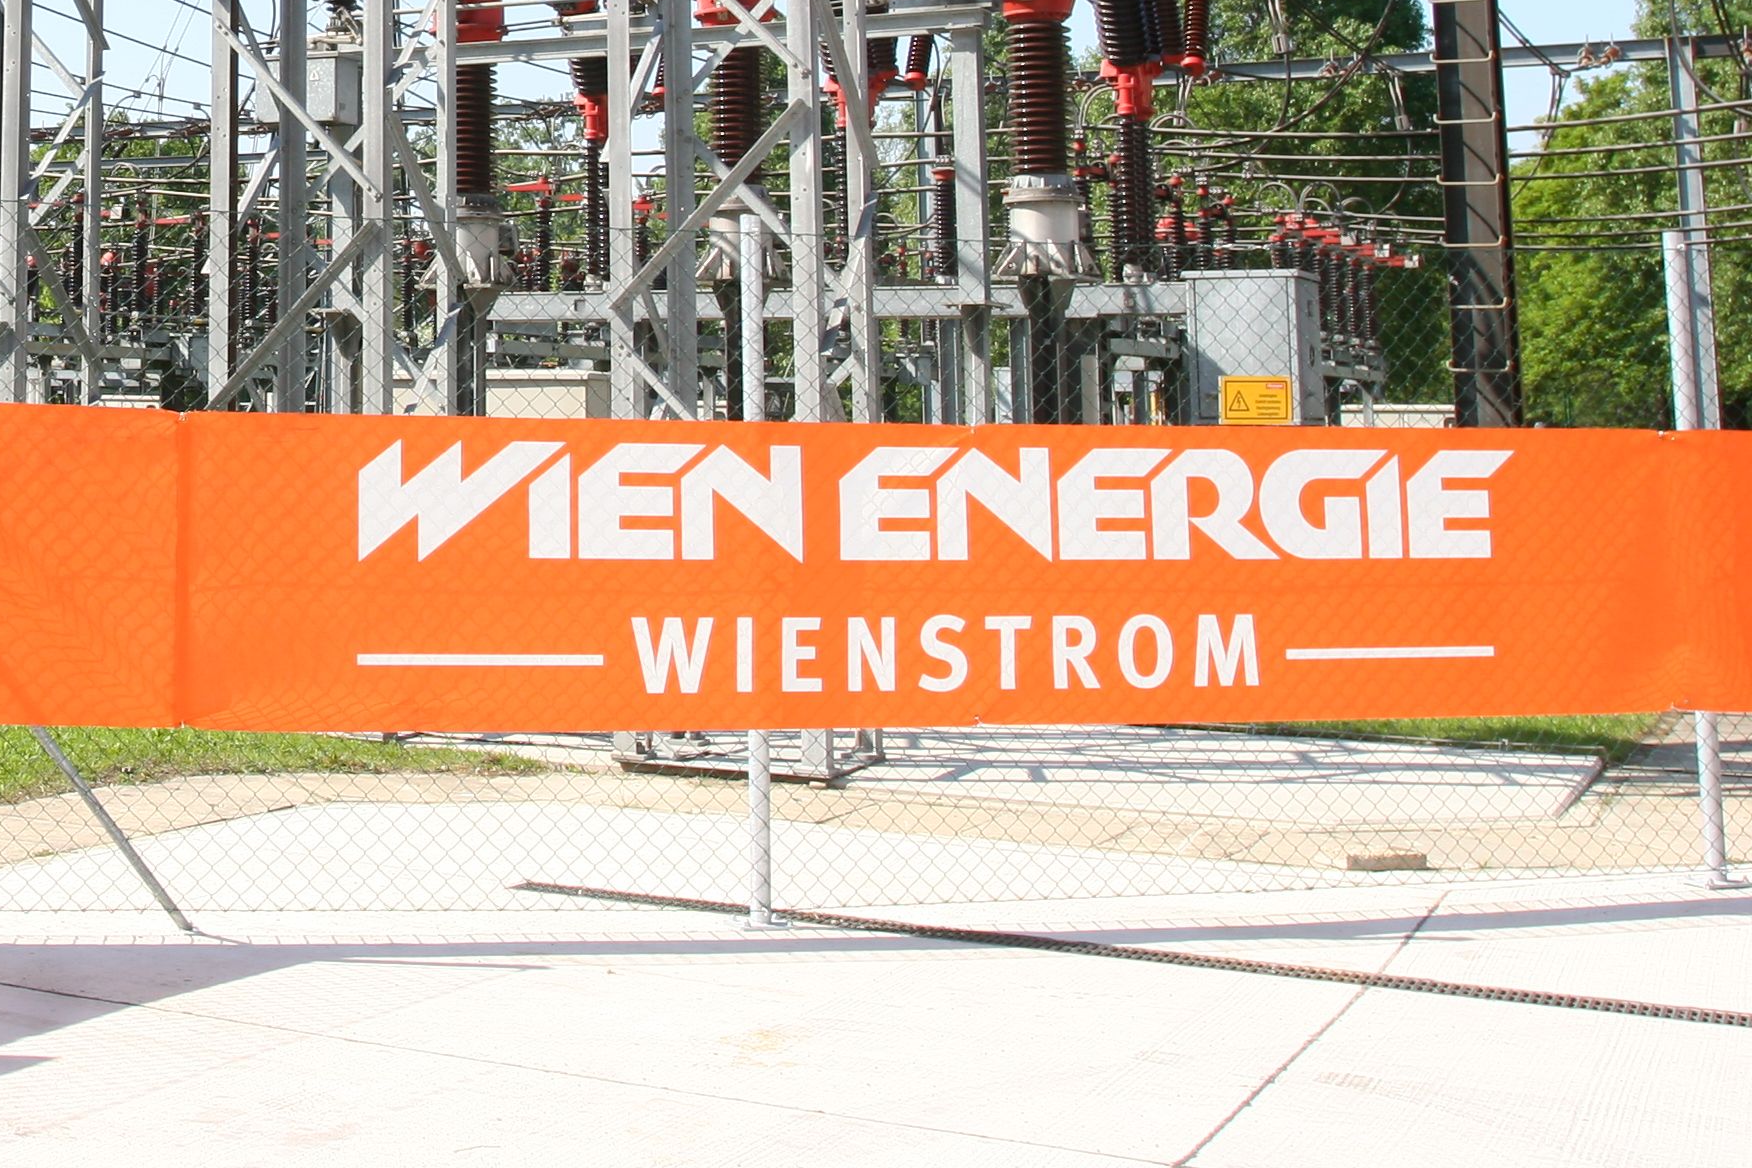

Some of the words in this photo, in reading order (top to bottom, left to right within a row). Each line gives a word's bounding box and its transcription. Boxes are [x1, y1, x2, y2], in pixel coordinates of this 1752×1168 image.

[359, 440, 803, 562] WIEN
[839, 447, 1513, 561] ENERGIE
[632, 615, 1259, 693] WIENSTROM
